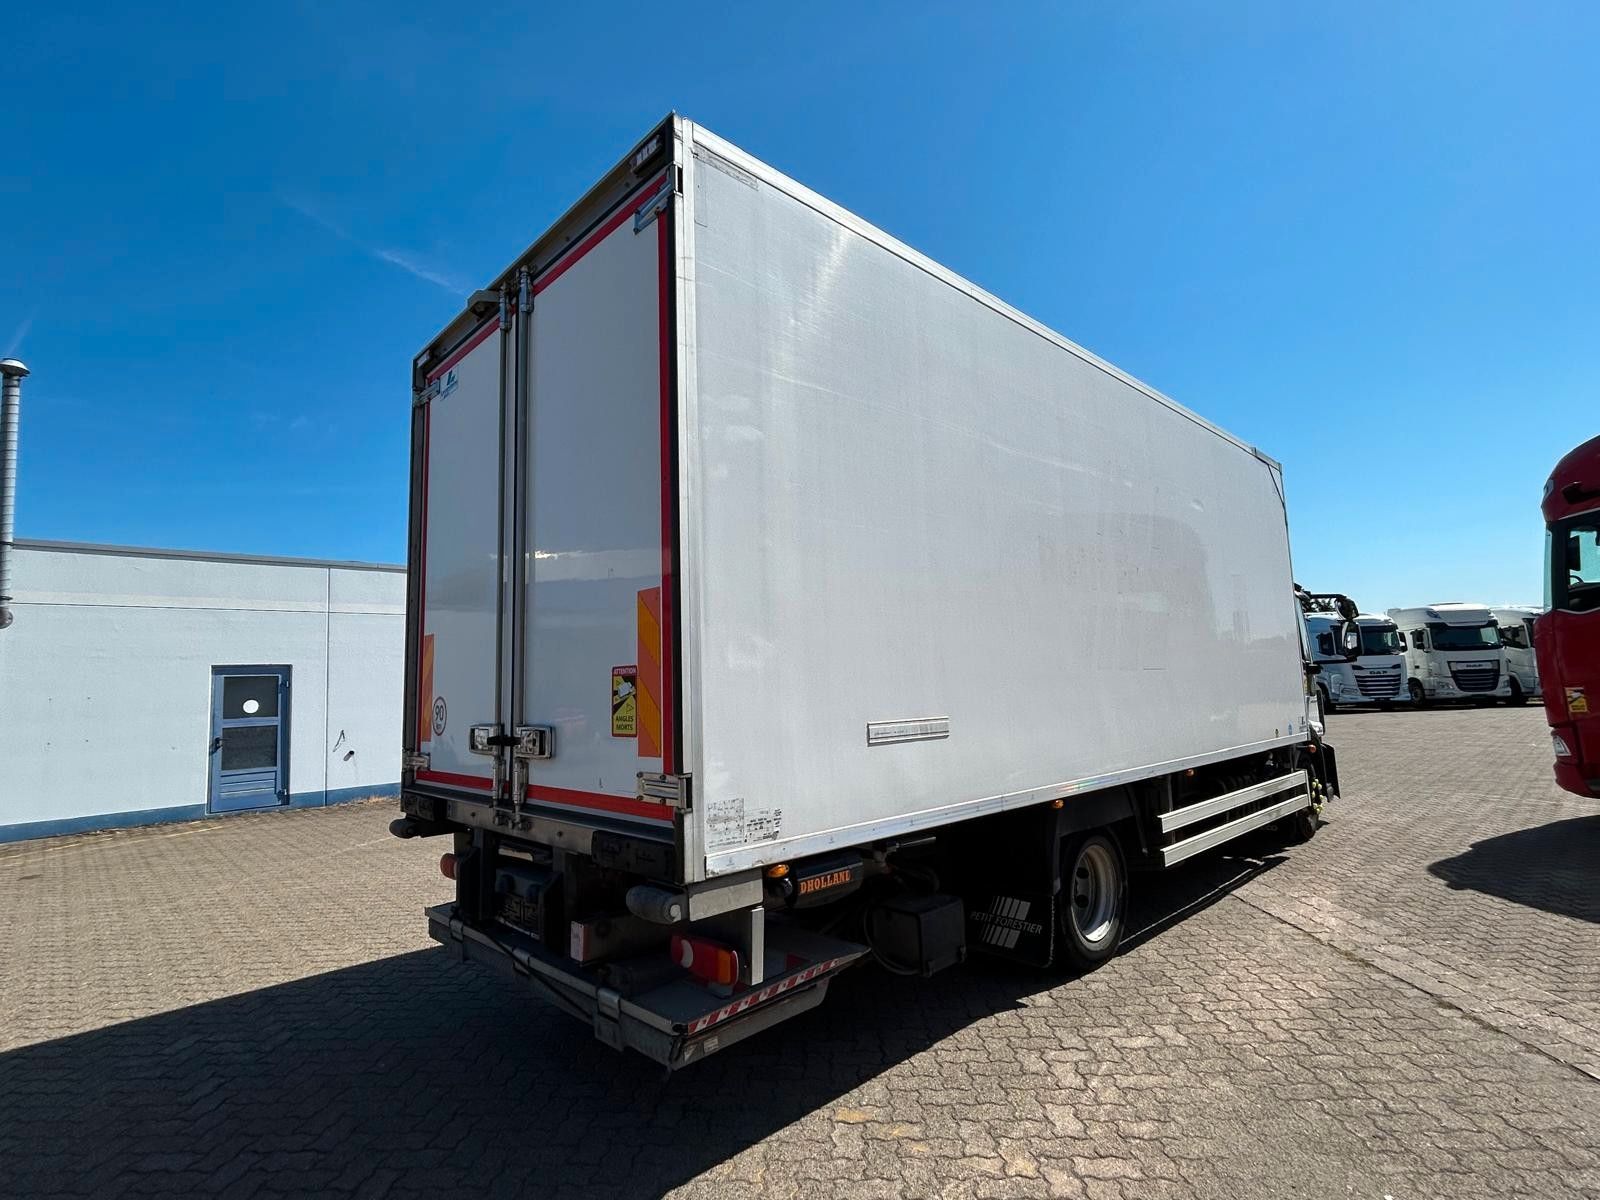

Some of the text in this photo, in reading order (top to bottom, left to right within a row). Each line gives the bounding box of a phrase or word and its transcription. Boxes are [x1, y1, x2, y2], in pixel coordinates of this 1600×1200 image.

[614, 667, 636, 675] ATTENTION
[435, 704, 444, 721] 90
[970, 911, 1043, 934] PETIT FORESTIER
